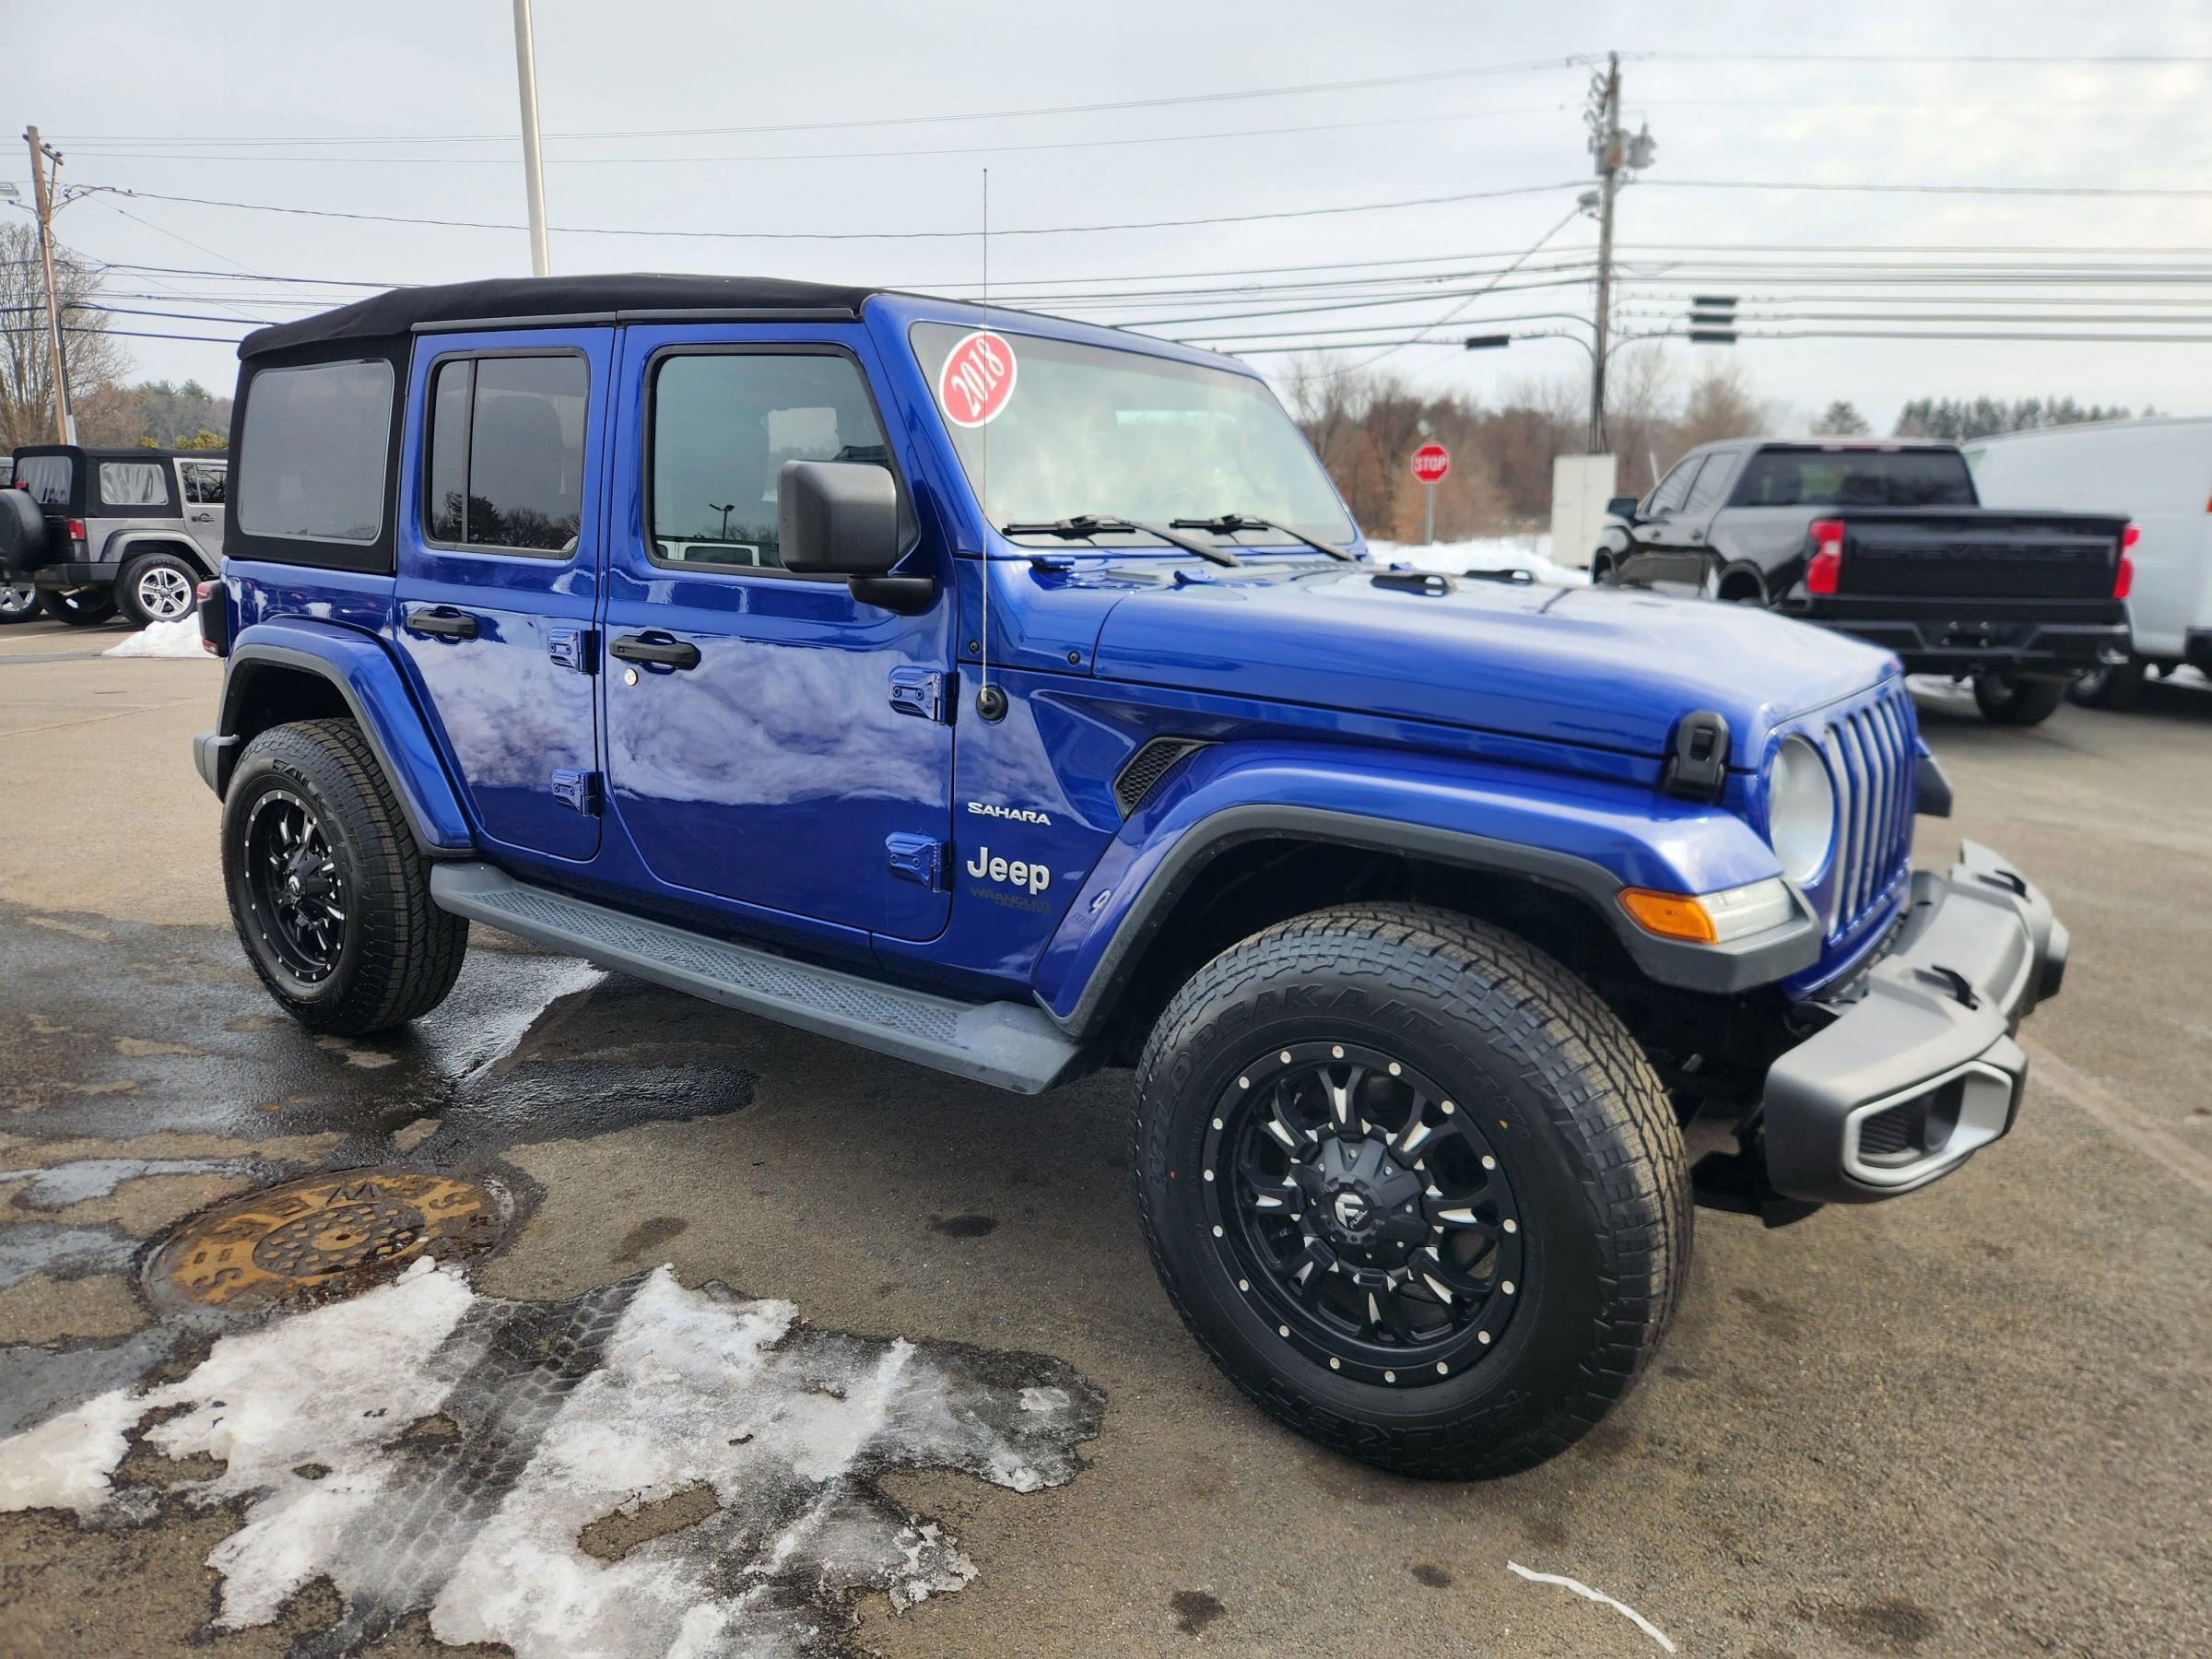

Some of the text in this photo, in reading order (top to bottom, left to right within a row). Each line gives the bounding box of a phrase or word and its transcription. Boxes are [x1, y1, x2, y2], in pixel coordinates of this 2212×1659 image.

[951, 337, 1005, 418] 2018
[1414, 454, 1447, 472] STOP
[968, 802, 1051, 825] SAHARA
[967, 846, 1050, 895] Jeep
[1348, 1208, 1370, 1229] FUEL
